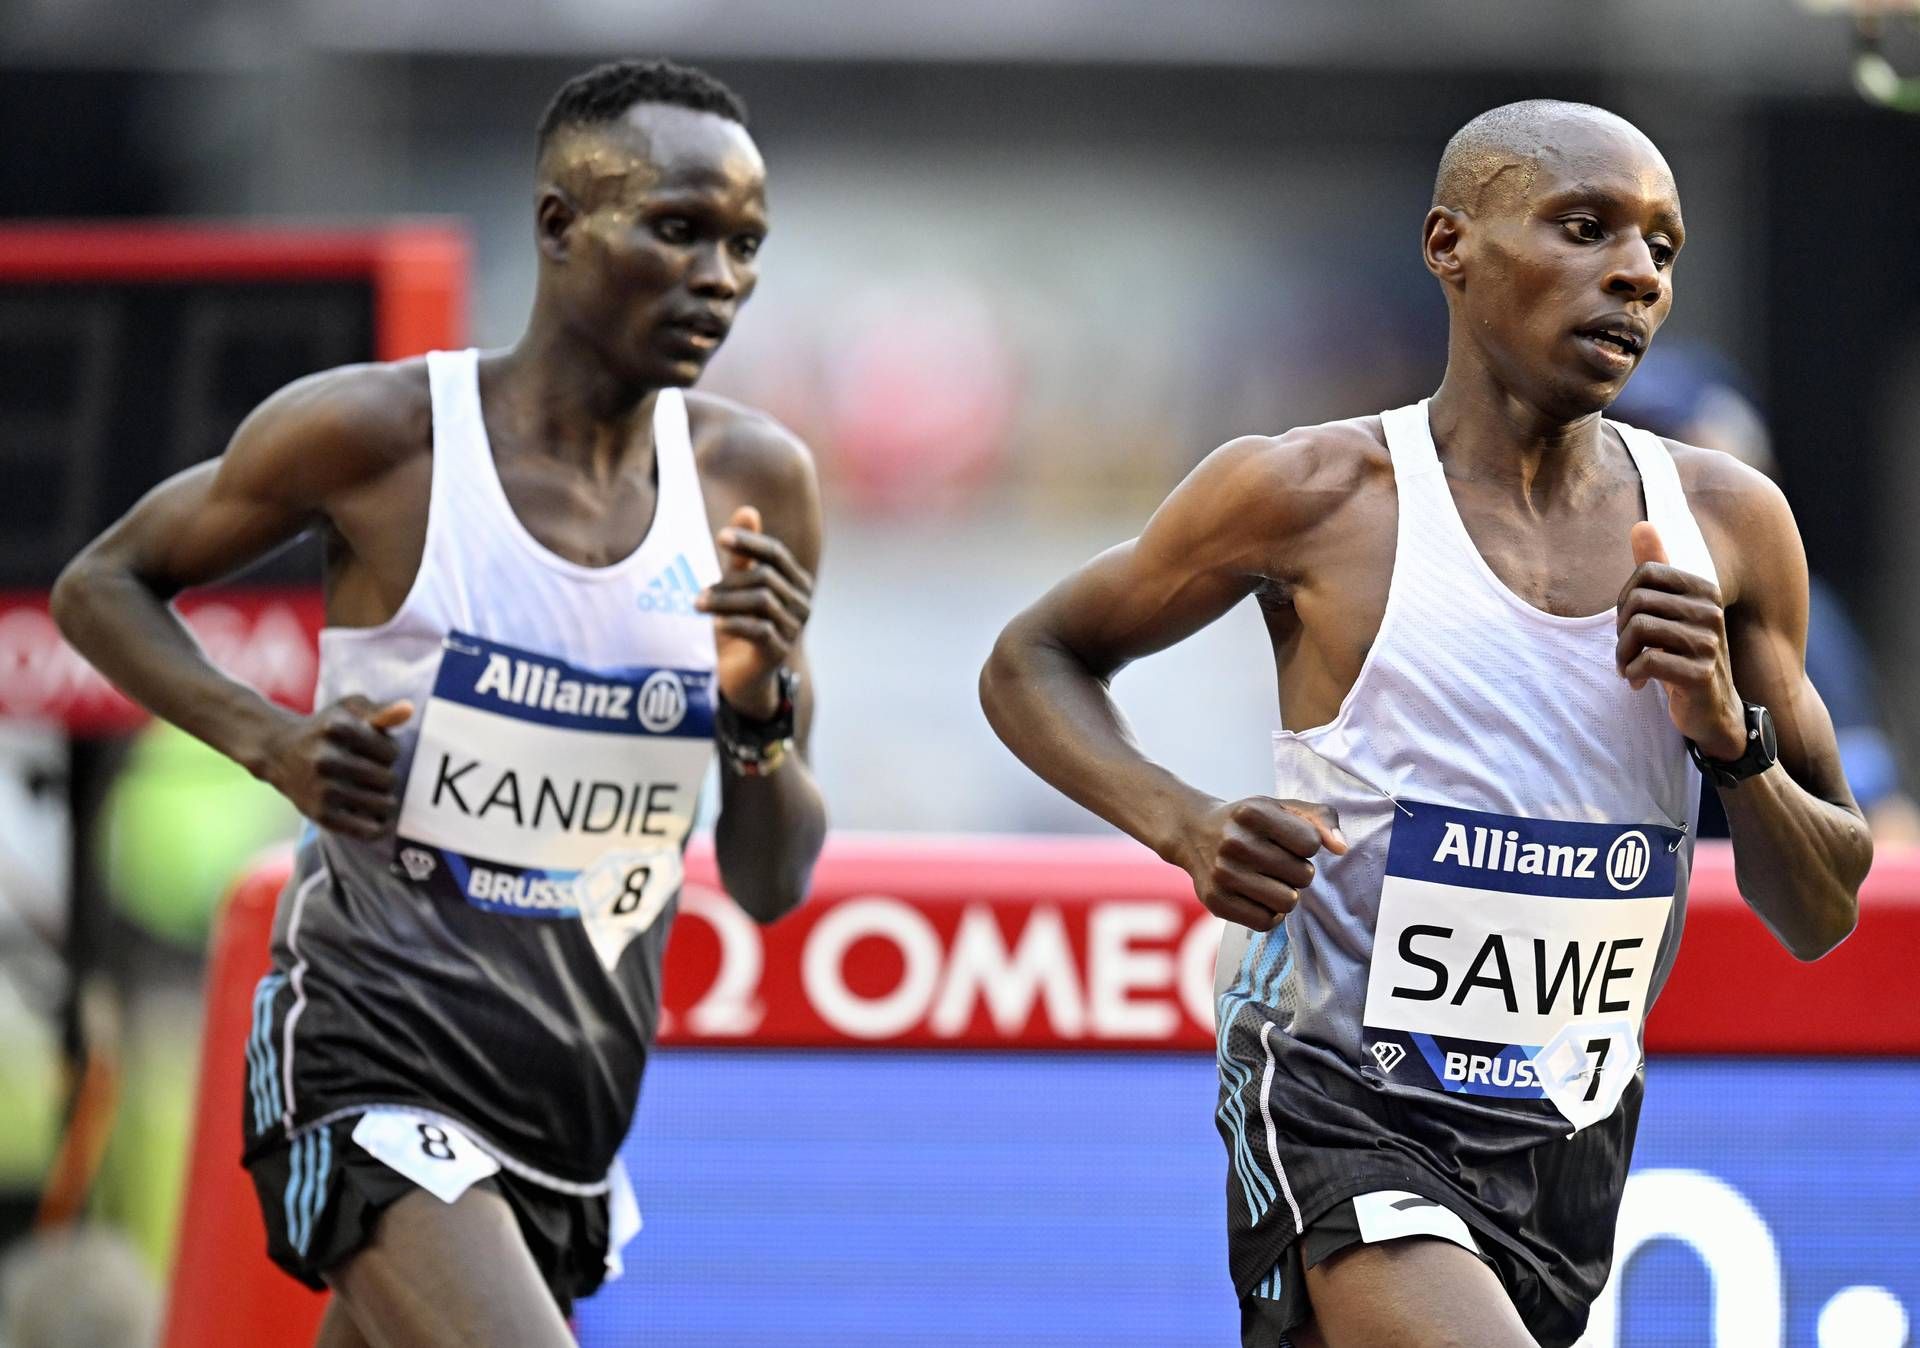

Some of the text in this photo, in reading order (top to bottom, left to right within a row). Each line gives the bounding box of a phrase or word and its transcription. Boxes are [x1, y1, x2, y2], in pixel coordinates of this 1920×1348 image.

[474, 653, 633, 719] Allianz
[431, 753, 679, 836] KANDIE
[1432, 822, 1598, 879] Allianz
[468, 867, 579, 909] BRUSS
[611, 866, 651, 914] 8
[802, 896, 1220, 1038] OME
[1391, 924, 1644, 1016] SAWE
[1582, 1037, 1611, 1101] 7
[417, 1123, 457, 1161] 8
